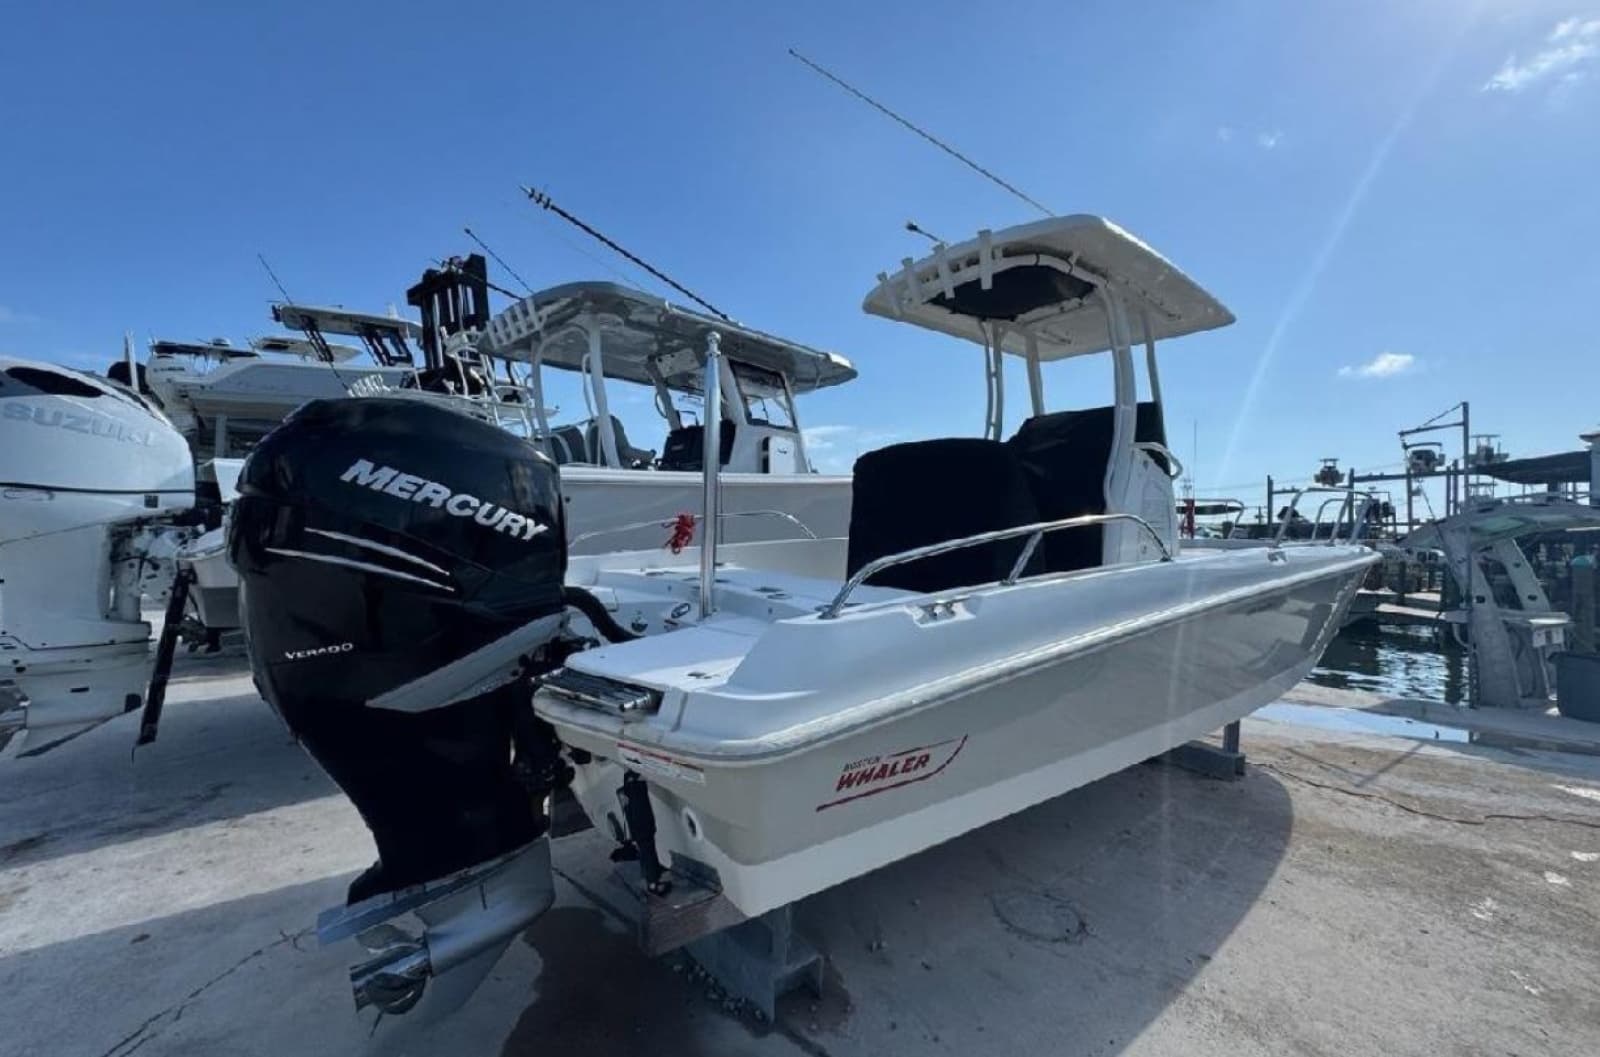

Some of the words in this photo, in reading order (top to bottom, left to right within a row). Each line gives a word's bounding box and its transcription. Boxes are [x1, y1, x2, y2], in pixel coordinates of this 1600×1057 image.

[2, 401, 155, 447] SUZUKI
[340, 458, 549, 541] MERCURY
[285, 642, 353, 659] VERADO
[836, 753, 931, 792] WHALER
